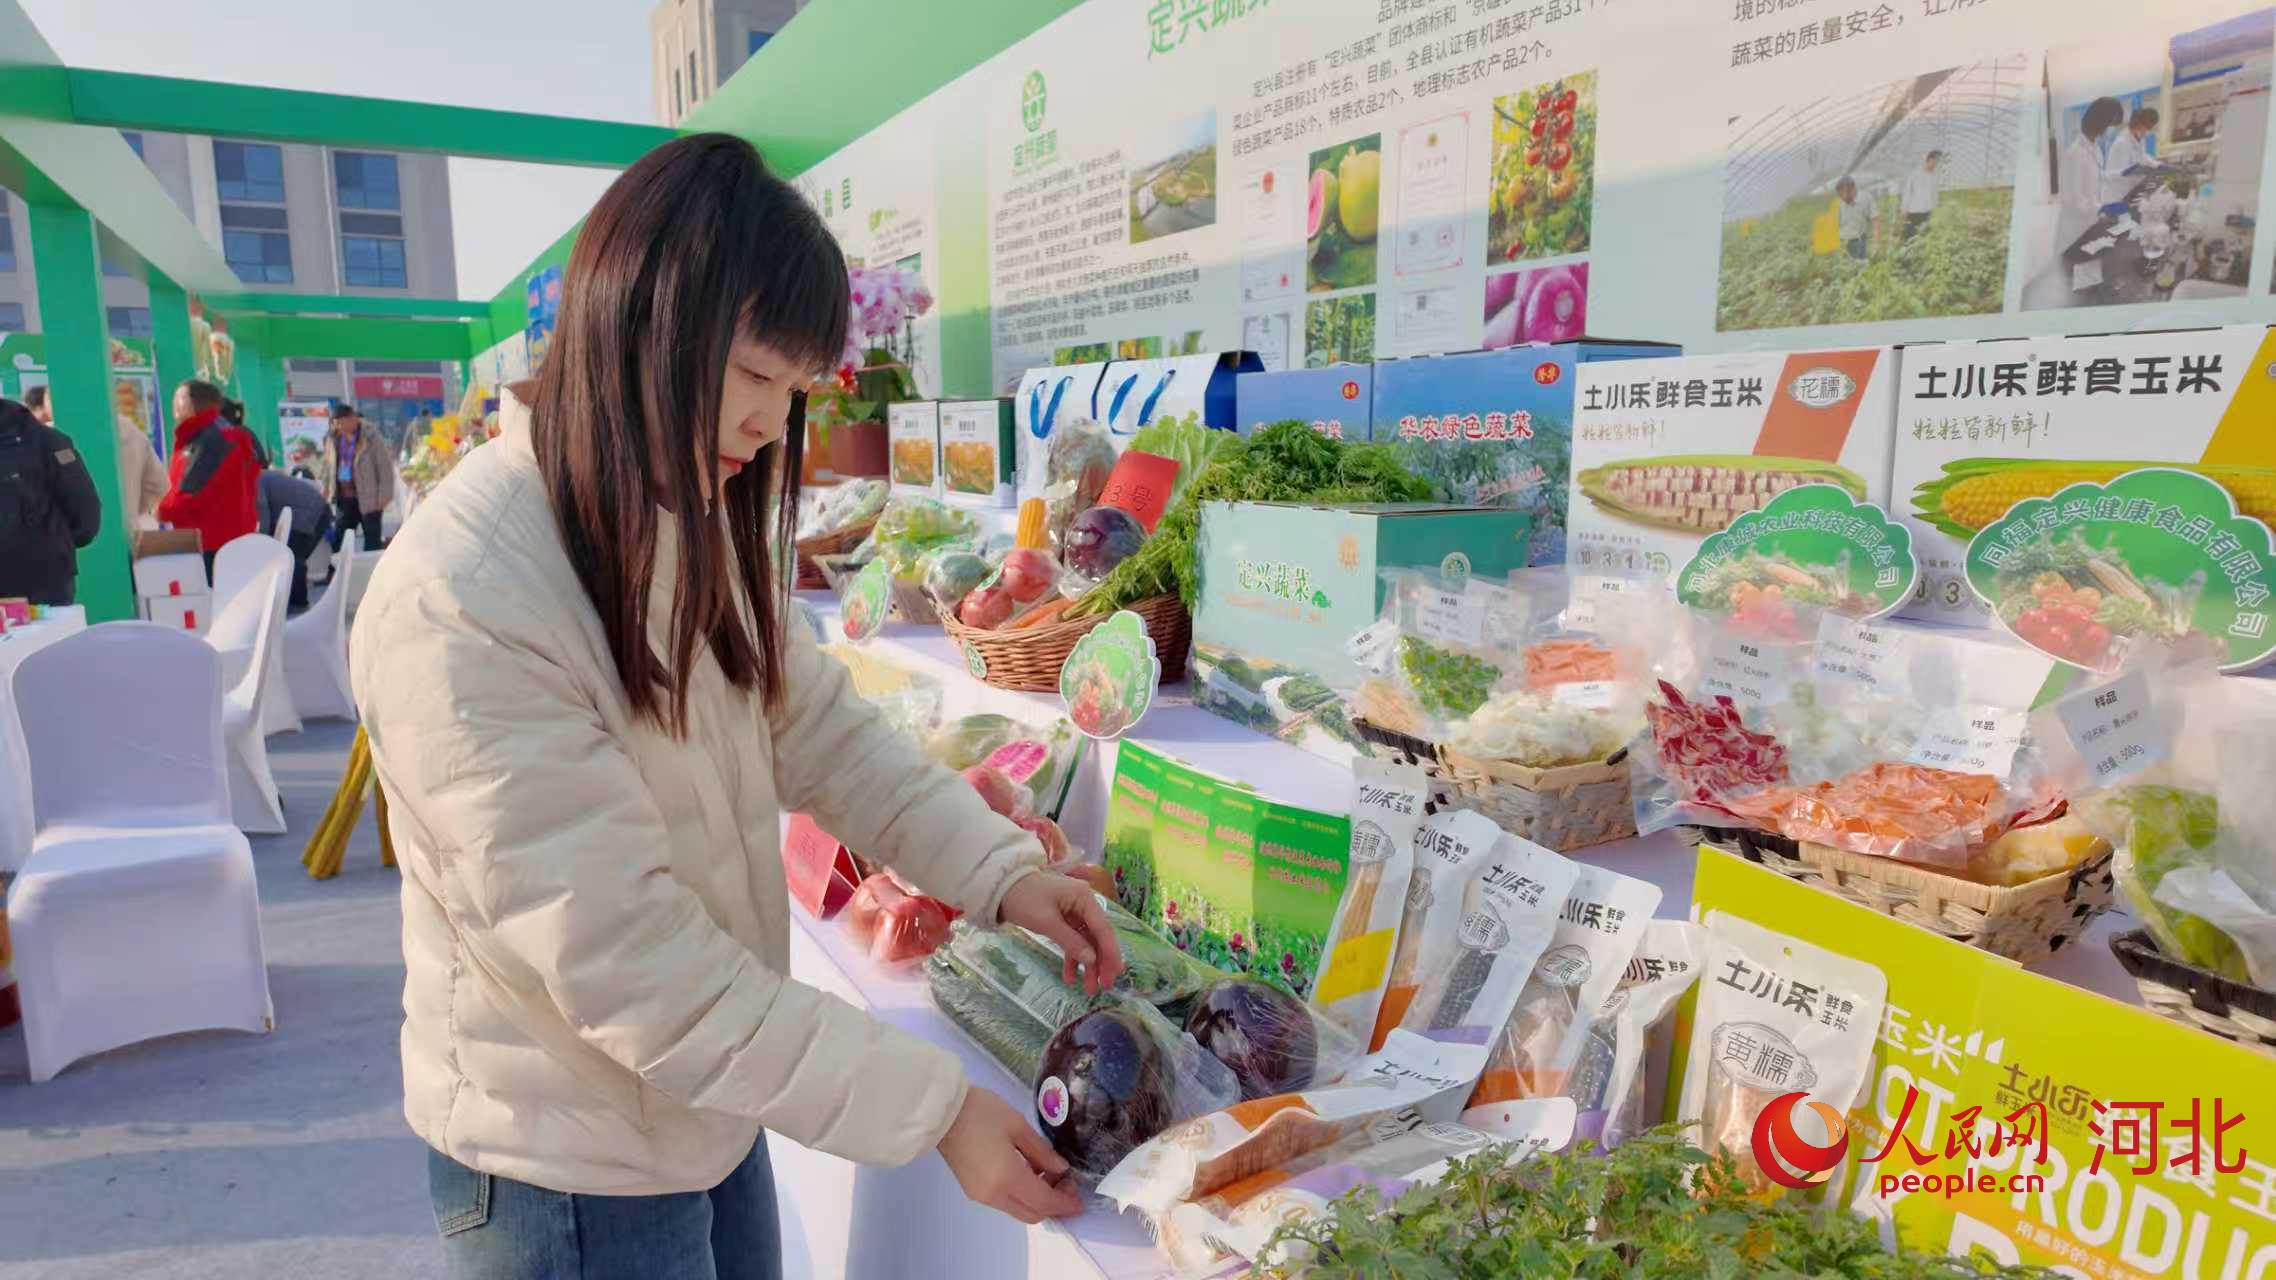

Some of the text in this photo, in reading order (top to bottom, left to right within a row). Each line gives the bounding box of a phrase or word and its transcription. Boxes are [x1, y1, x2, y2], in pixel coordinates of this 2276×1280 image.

[1377, 0, 1438, 24] 品牌
[1733, 0, 1816, 22] 境的
[1147, 0, 1269, 61] 定兴
[1799, 376, 1841, 400] 花糯
[1914, 354, 2223, 399] 土小乐鲜食玉米
[1583, 377, 1762, 410] 土小乐鲜食玉米
[1979, 495, 2270, 639] 同福定兴健康食品有限公司
[2095, 690, 2118, 708] 样品
[1972, 720, 1995, 731] 样品
[1482, 864, 1533, 894] 土小乐
[1559, 898, 1604, 930] 小乐
[1717, 959, 1819, 1018] 土小乐
[1824, 992, 1855, 1015] 鲜食
[1819, 1009, 1849, 1033] 玉米
[1722, 1030, 1795, 1086] 黄糯
